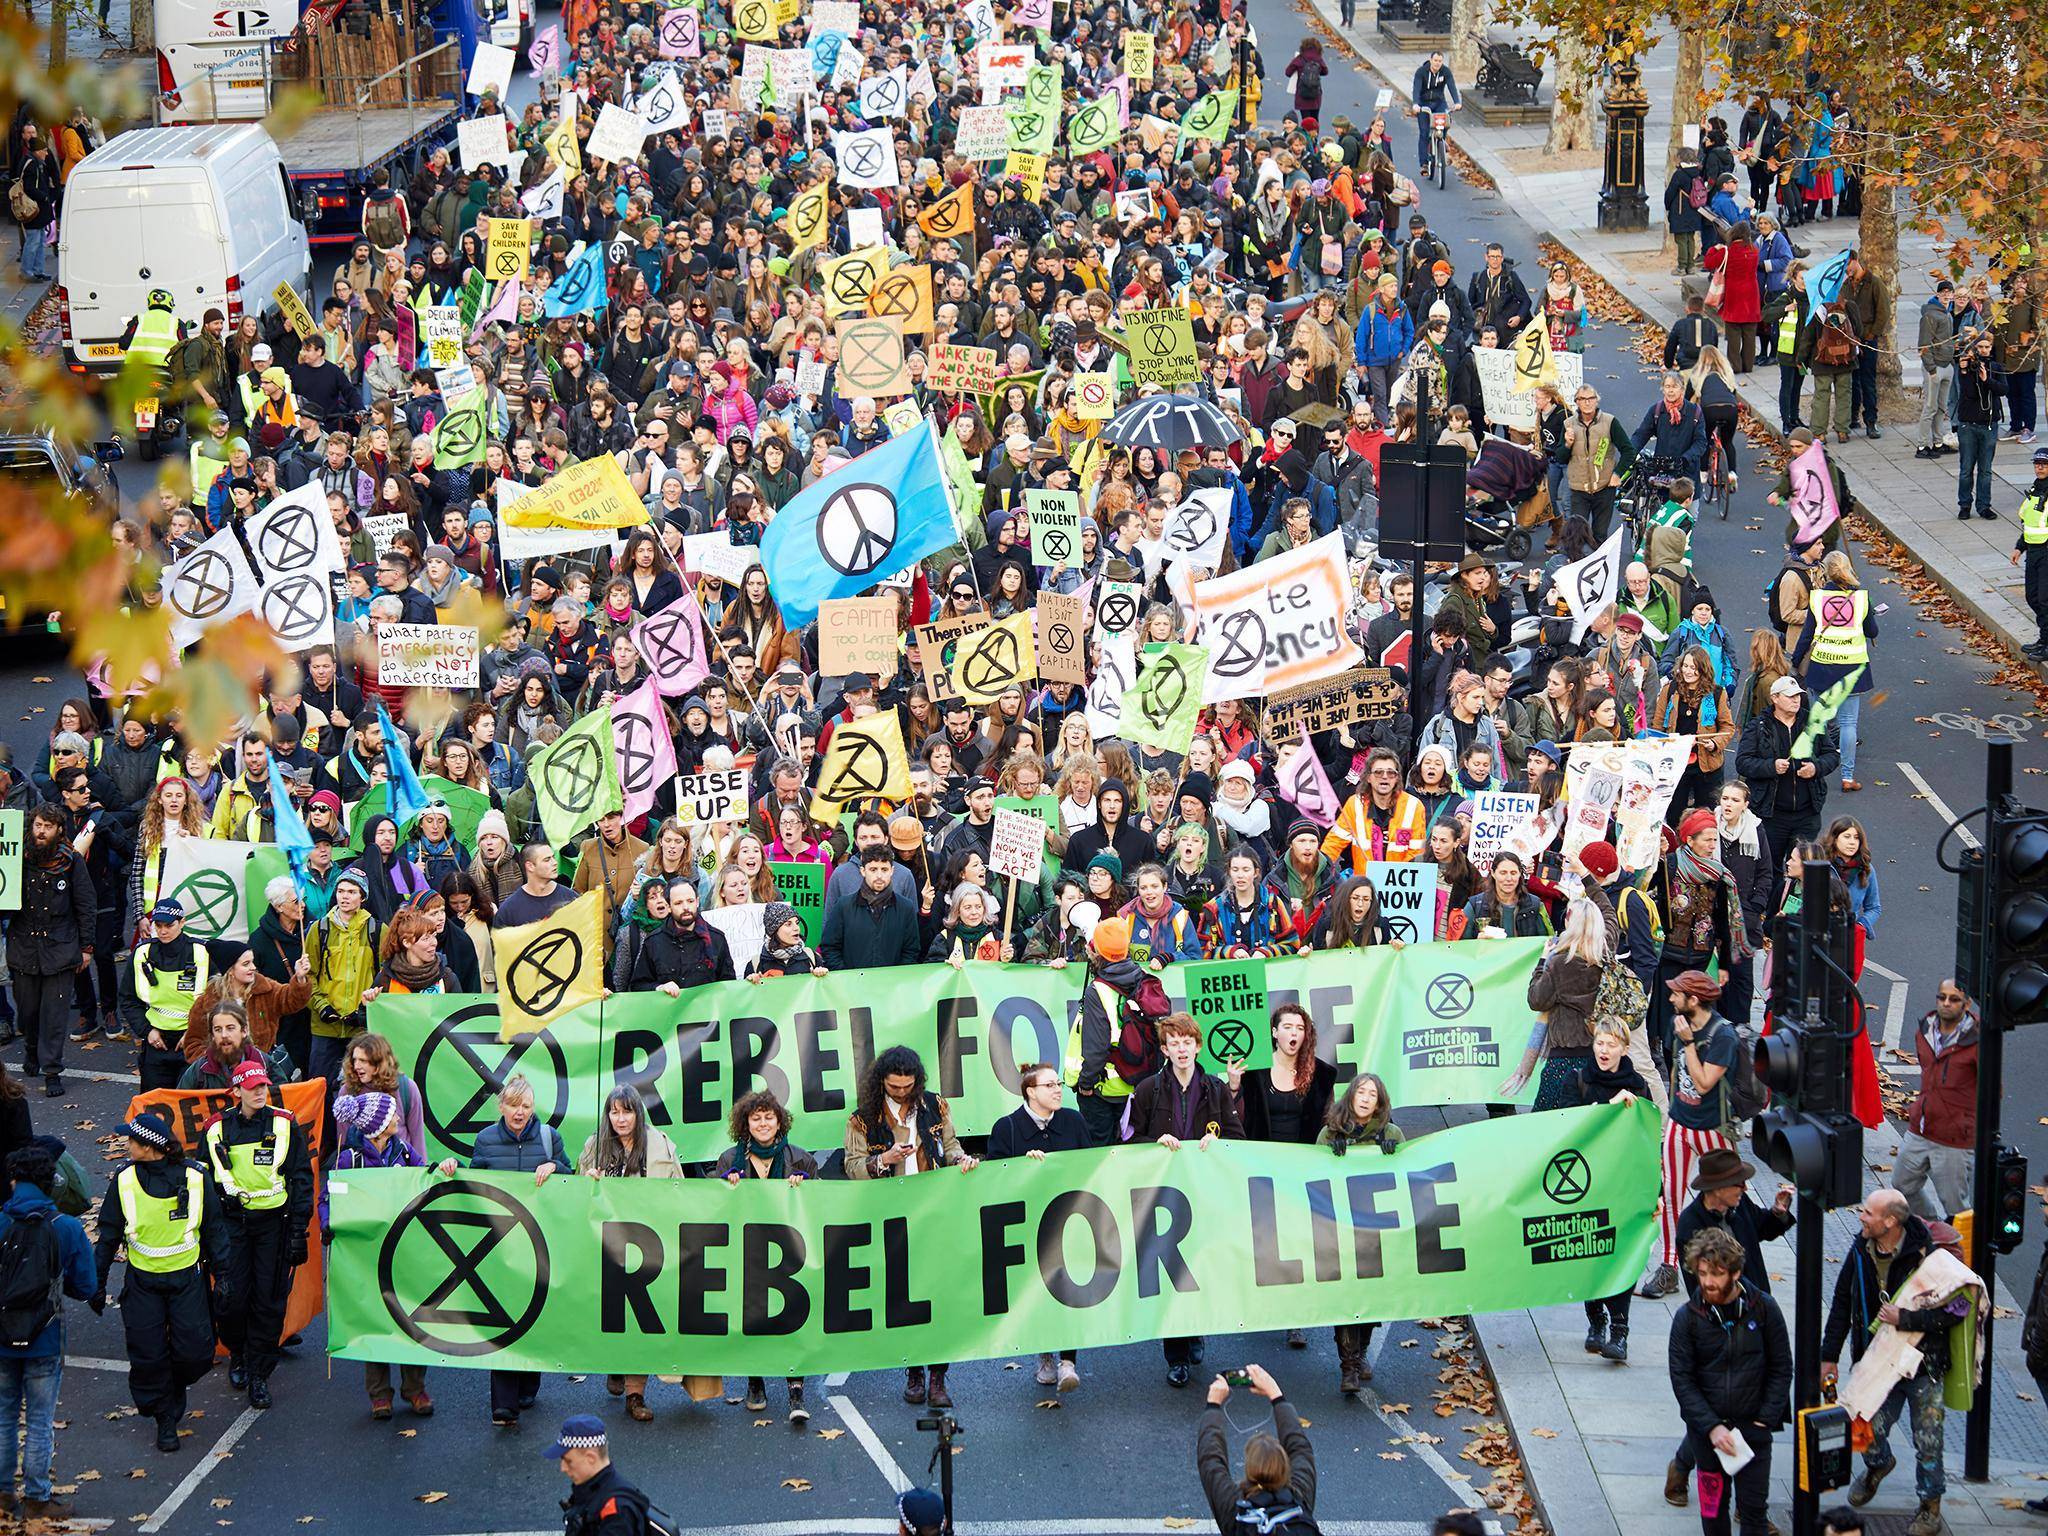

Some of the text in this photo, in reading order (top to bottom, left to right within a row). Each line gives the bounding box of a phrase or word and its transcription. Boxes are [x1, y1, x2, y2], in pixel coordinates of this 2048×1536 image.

[247, 28, 277, 36] PETERS
[963, 117, 987, 130] right
[973, 148, 982, 157] of
[1019, 156, 1035, 165] SAVE
[1019, 164, 1032, 172] OUR
[501, 222, 520, 231] SAVE
[492, 240, 526, 248] CHILDREN
[428, 309, 459, 321] DECLARE
[1140, 311, 1159, 324] NOT
[1161, 308, 1186, 322] FINE
[429, 325, 461, 336] CLIMATE
[92, 346, 114, 355] KN63
[433, 350, 457, 360] ENCY
[935, 346, 993, 364] WAKE UP
[1138, 355, 1195, 368] STOP LYING
[1480, 353, 1499, 366] The
[937, 362, 995, 379] AND SMELL
[1138, 366, 1199, 383] DO Something!
[929, 375, 995, 392] THE CARBON
[1500, 404, 1522, 416] WILL
[141, 413, 150, 423] L
[1040, 499, 1066, 512] NON
[364, 517, 404, 531] HOW CAN
[1032, 513, 1077, 527] VIOLENT
[1111, 583, 1133, 593] FOR
[1040, 593, 1079, 610] NATURE
[379, 626, 477, 642] What part of
[920, 622, 962, 644] There
[963, 620, 974, 633] is
[833, 634, 895, 646] TOO LATE
[1817, 636, 1853, 645] EXTINCTION
[381, 642, 476, 660] EMERGENCY
[847, 651, 857, 663] A
[1815, 650, 1849, 660] REBELLION
[381, 660, 397, 672] do
[402, 660, 427, 673] you
[1039, 655, 1084, 672] CAPITAL
[382, 672, 478, 685] understand?
[1325, 688, 1349, 706] ARE
[1326, 706, 1350, 726] ARE
[1357, 702, 1391, 717] SEAS
[681, 771, 743, 798] RISE
[695, 796, 731, 821] UP
[1481, 796, 1534, 813] LISTEN
[1000, 812, 1044, 831] THE SCIENCE
[1491, 815, 1504, 823] TO
[996, 834, 1041, 851] TECHNOLOGY
[1007, 831, 1024, 840] HAVE
[1028, 836, 1041, 845] THE
[1475, 840, 1491, 849] NOT
[995, 843, 1035, 860] NOW WE
[992, 851, 1036, 869] NEED TO
[1001, 862, 1028, 877] ACT
[1385, 868, 1419, 887] ACT
[793, 892, 820, 907] LIFE
[1378, 891, 1423, 910] NOW
[1201, 973, 1251, 995] REBEL
[1191, 993, 1264, 1016] FOR LIFE
[1406, 1028, 1480, 1048] extinction
[1427, 1047, 1497, 1066] rebellion
[613, 1006, 878, 1127] REBEL
[1526, 1213, 1600, 1238] extinction
[600, 1161, 1466, 1336] REBEL FOR LIFE
[1549, 1230, 1613, 1260] rebellion
